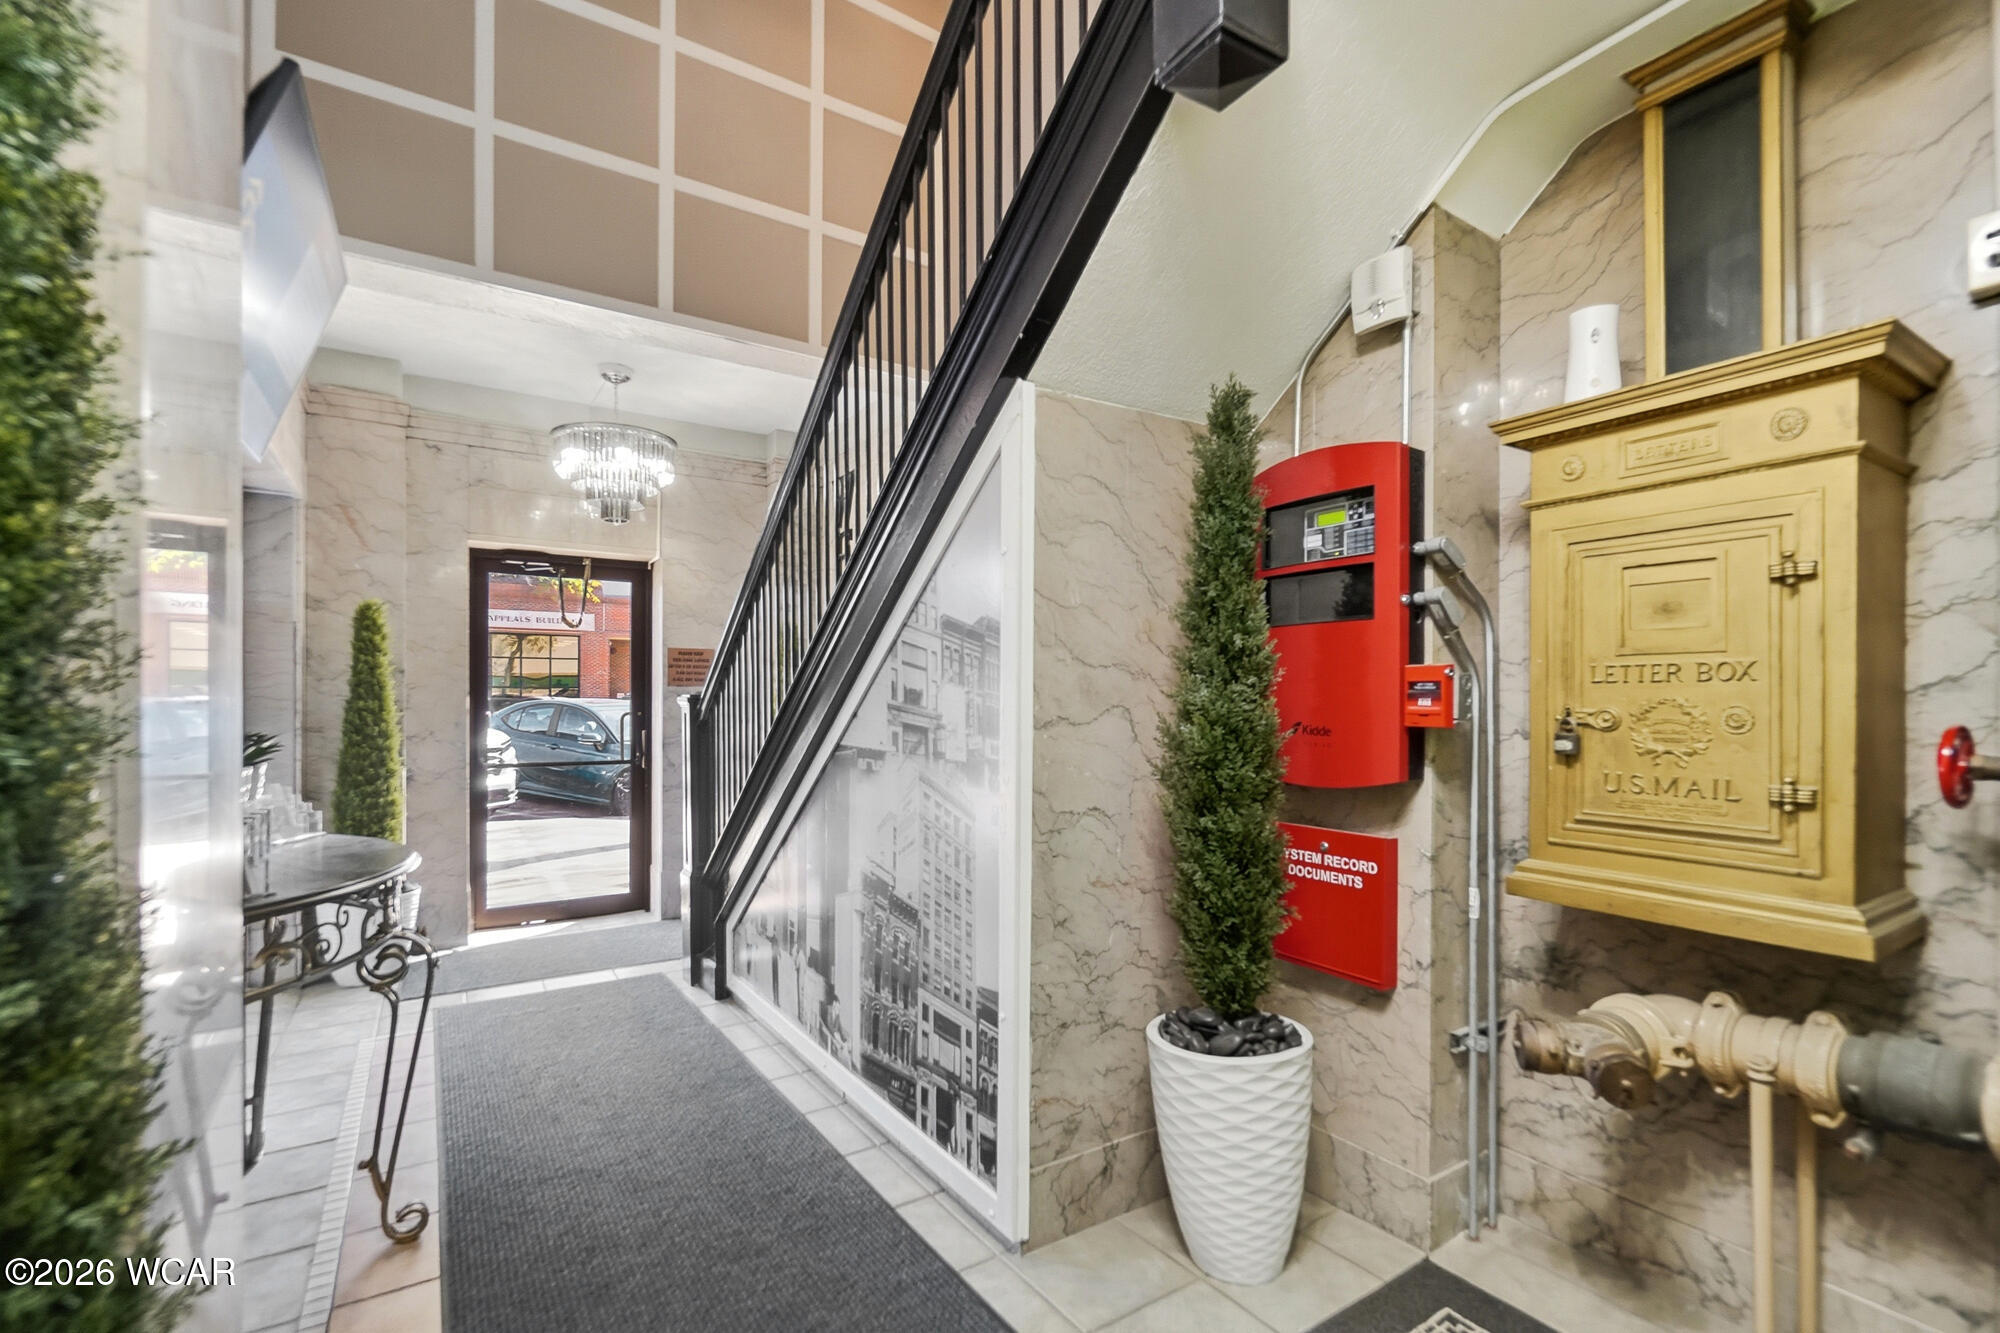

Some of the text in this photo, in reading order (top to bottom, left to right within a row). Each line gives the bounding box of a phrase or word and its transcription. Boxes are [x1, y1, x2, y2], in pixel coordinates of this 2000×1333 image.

[1589, 660, 1758, 684] LETTER BOX
[1302, 724, 1332, 737] Kidde
[1283, 847, 1379, 875] YSTEM RECORD
[1288, 863, 1364, 889] DOCUMENTS
